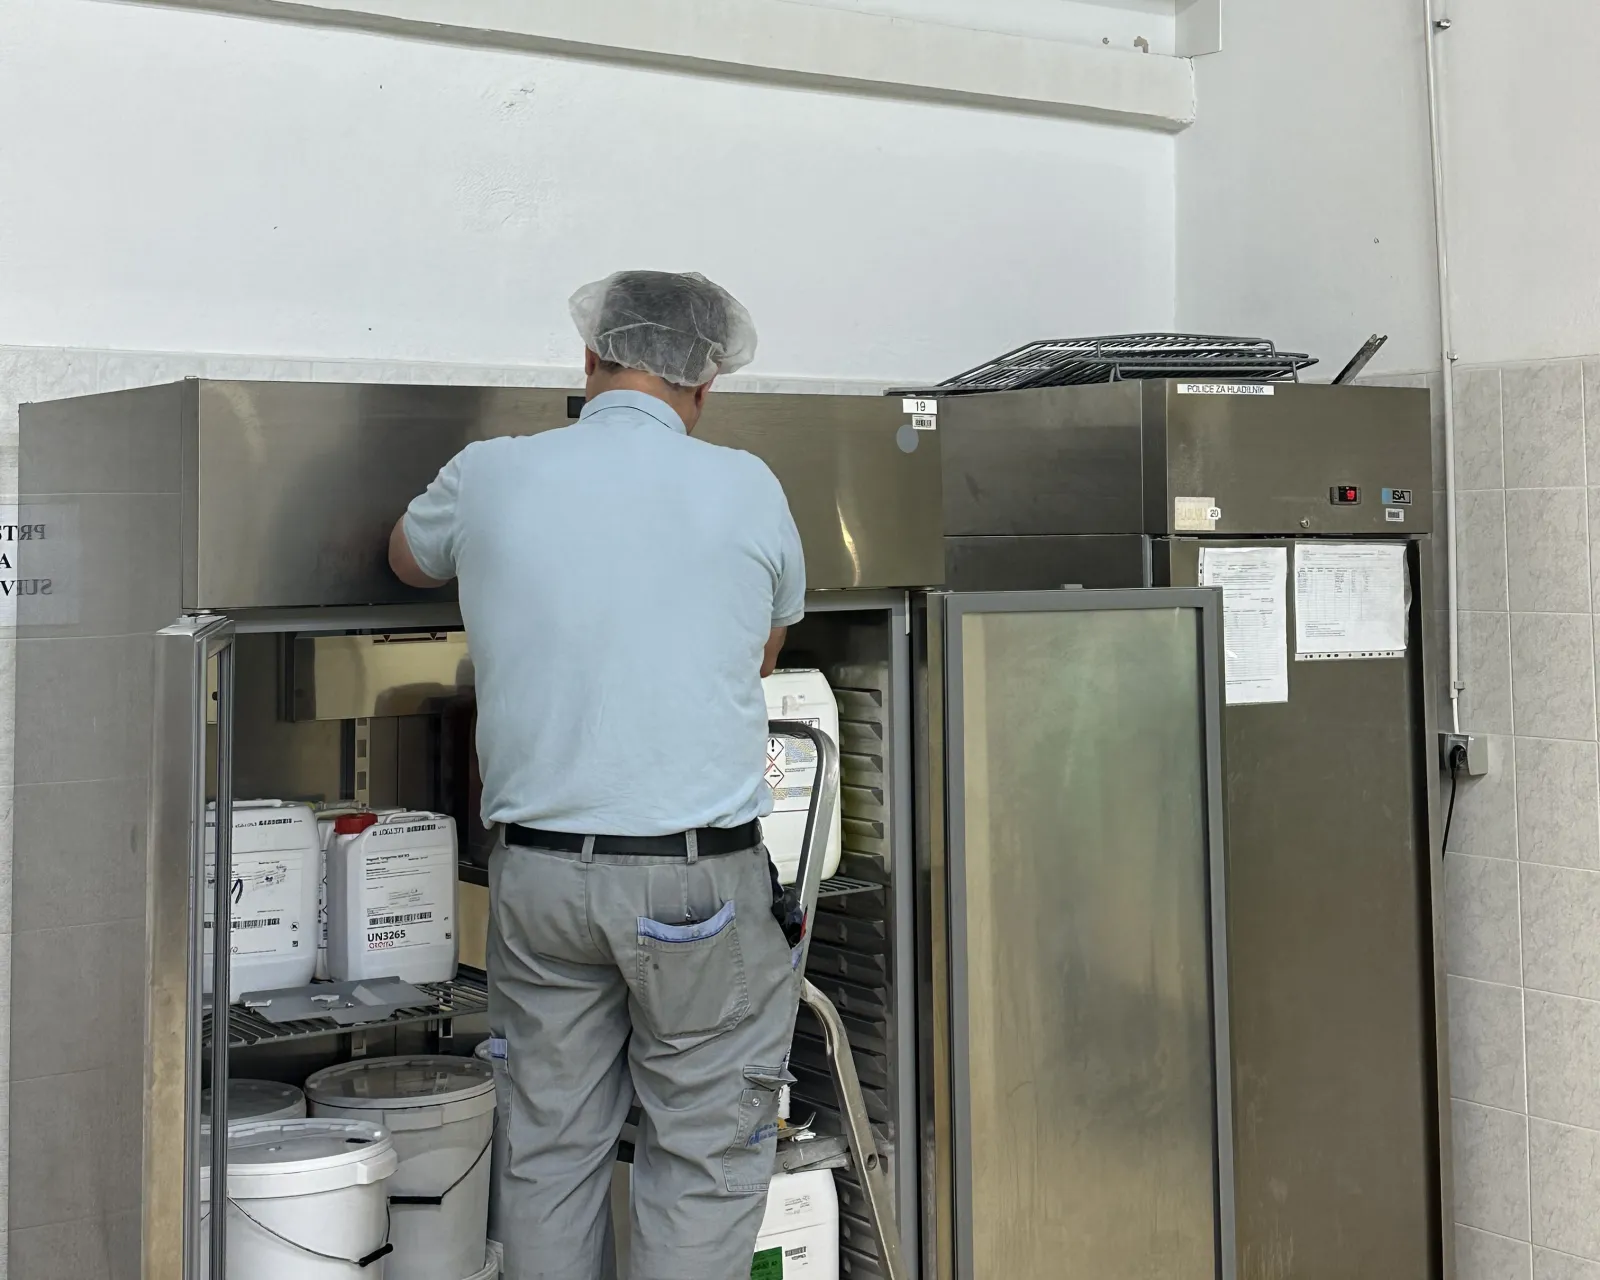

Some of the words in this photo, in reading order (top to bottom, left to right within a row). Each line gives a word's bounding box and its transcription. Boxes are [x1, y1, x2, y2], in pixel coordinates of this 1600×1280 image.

[1187, 384, 1214, 394] POLICE
[1216, 384, 1226, 394] ZA
[1227, 385, 1265, 394] HLADILNIK
[915, 401, 926, 411] 19
[1209, 509, 1219, 518] 20
[367, 929, 406, 942] UN3265
